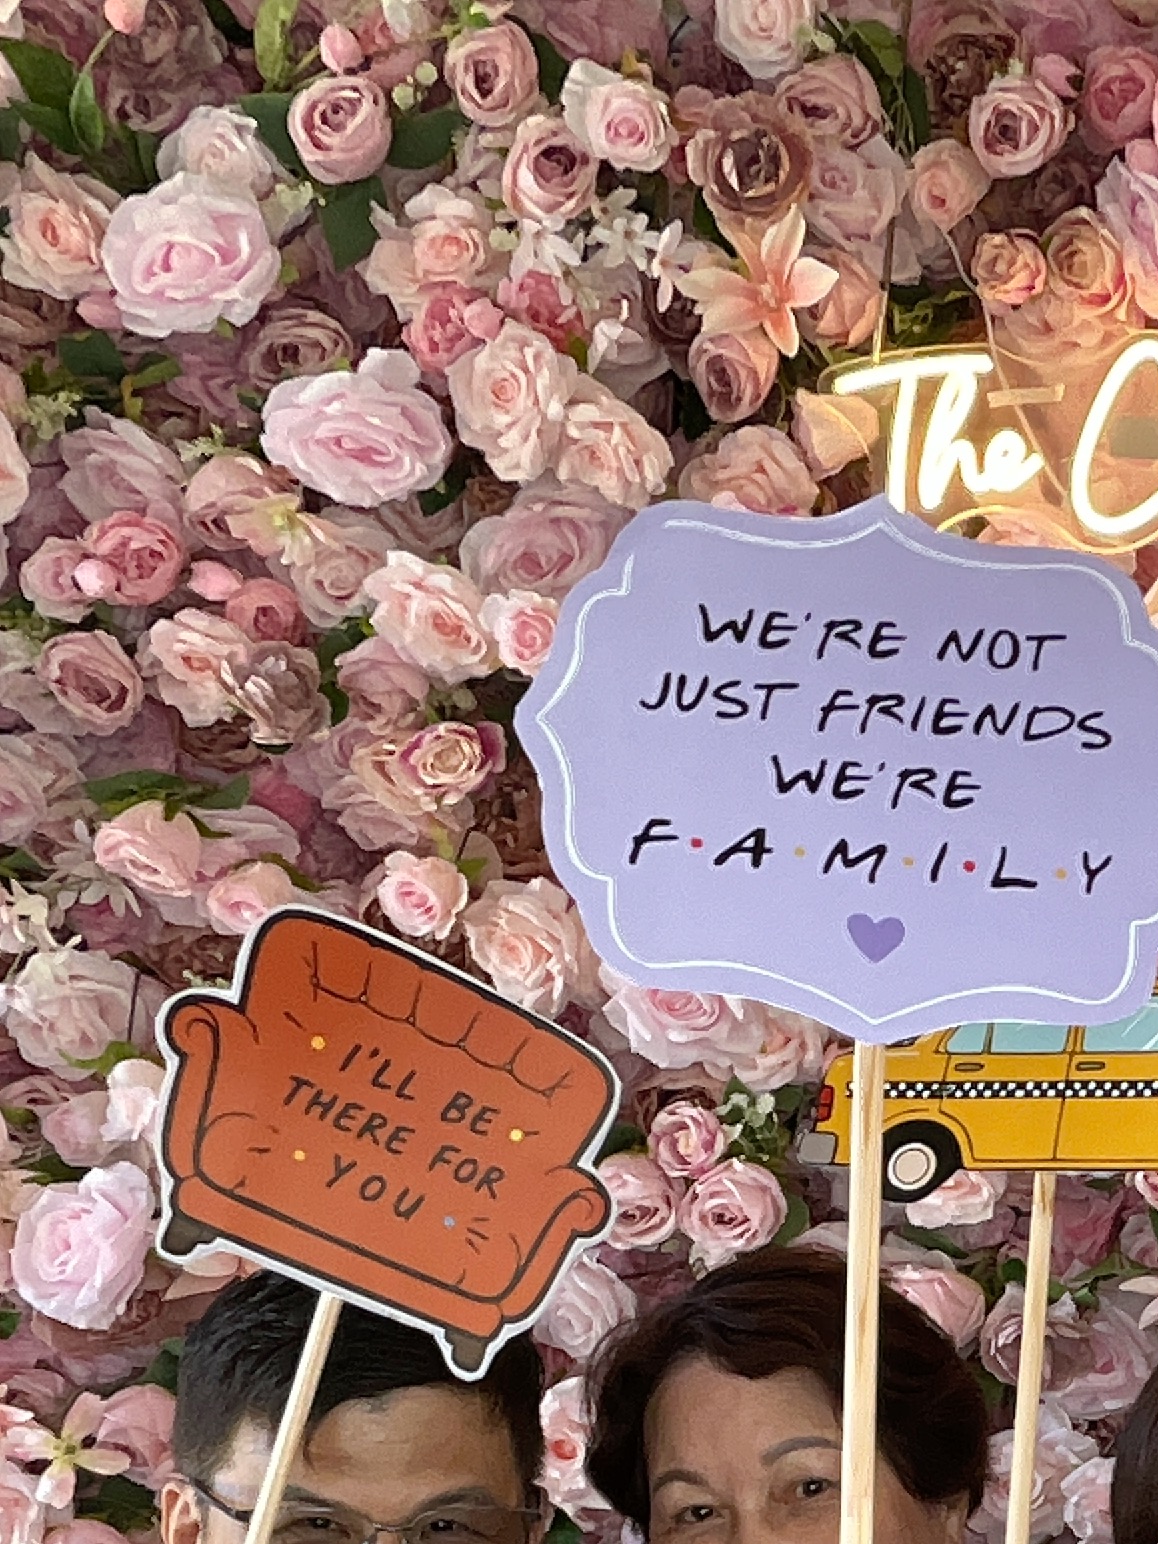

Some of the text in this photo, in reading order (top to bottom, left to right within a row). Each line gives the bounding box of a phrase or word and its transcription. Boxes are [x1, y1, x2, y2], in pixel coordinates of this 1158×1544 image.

[832, 351, 1044, 514] The
[698, 603, 1068, 672] WE'RE NOT
[639, 672, 1112, 750] JUST FRIENDS
[770, 754, 982, 810] WE'RE
[338, 1042, 501, 1137] I'LL BE
[282, 1074, 507, 1201] THERE FOR
[325, 1153, 426, 1222] YOU
